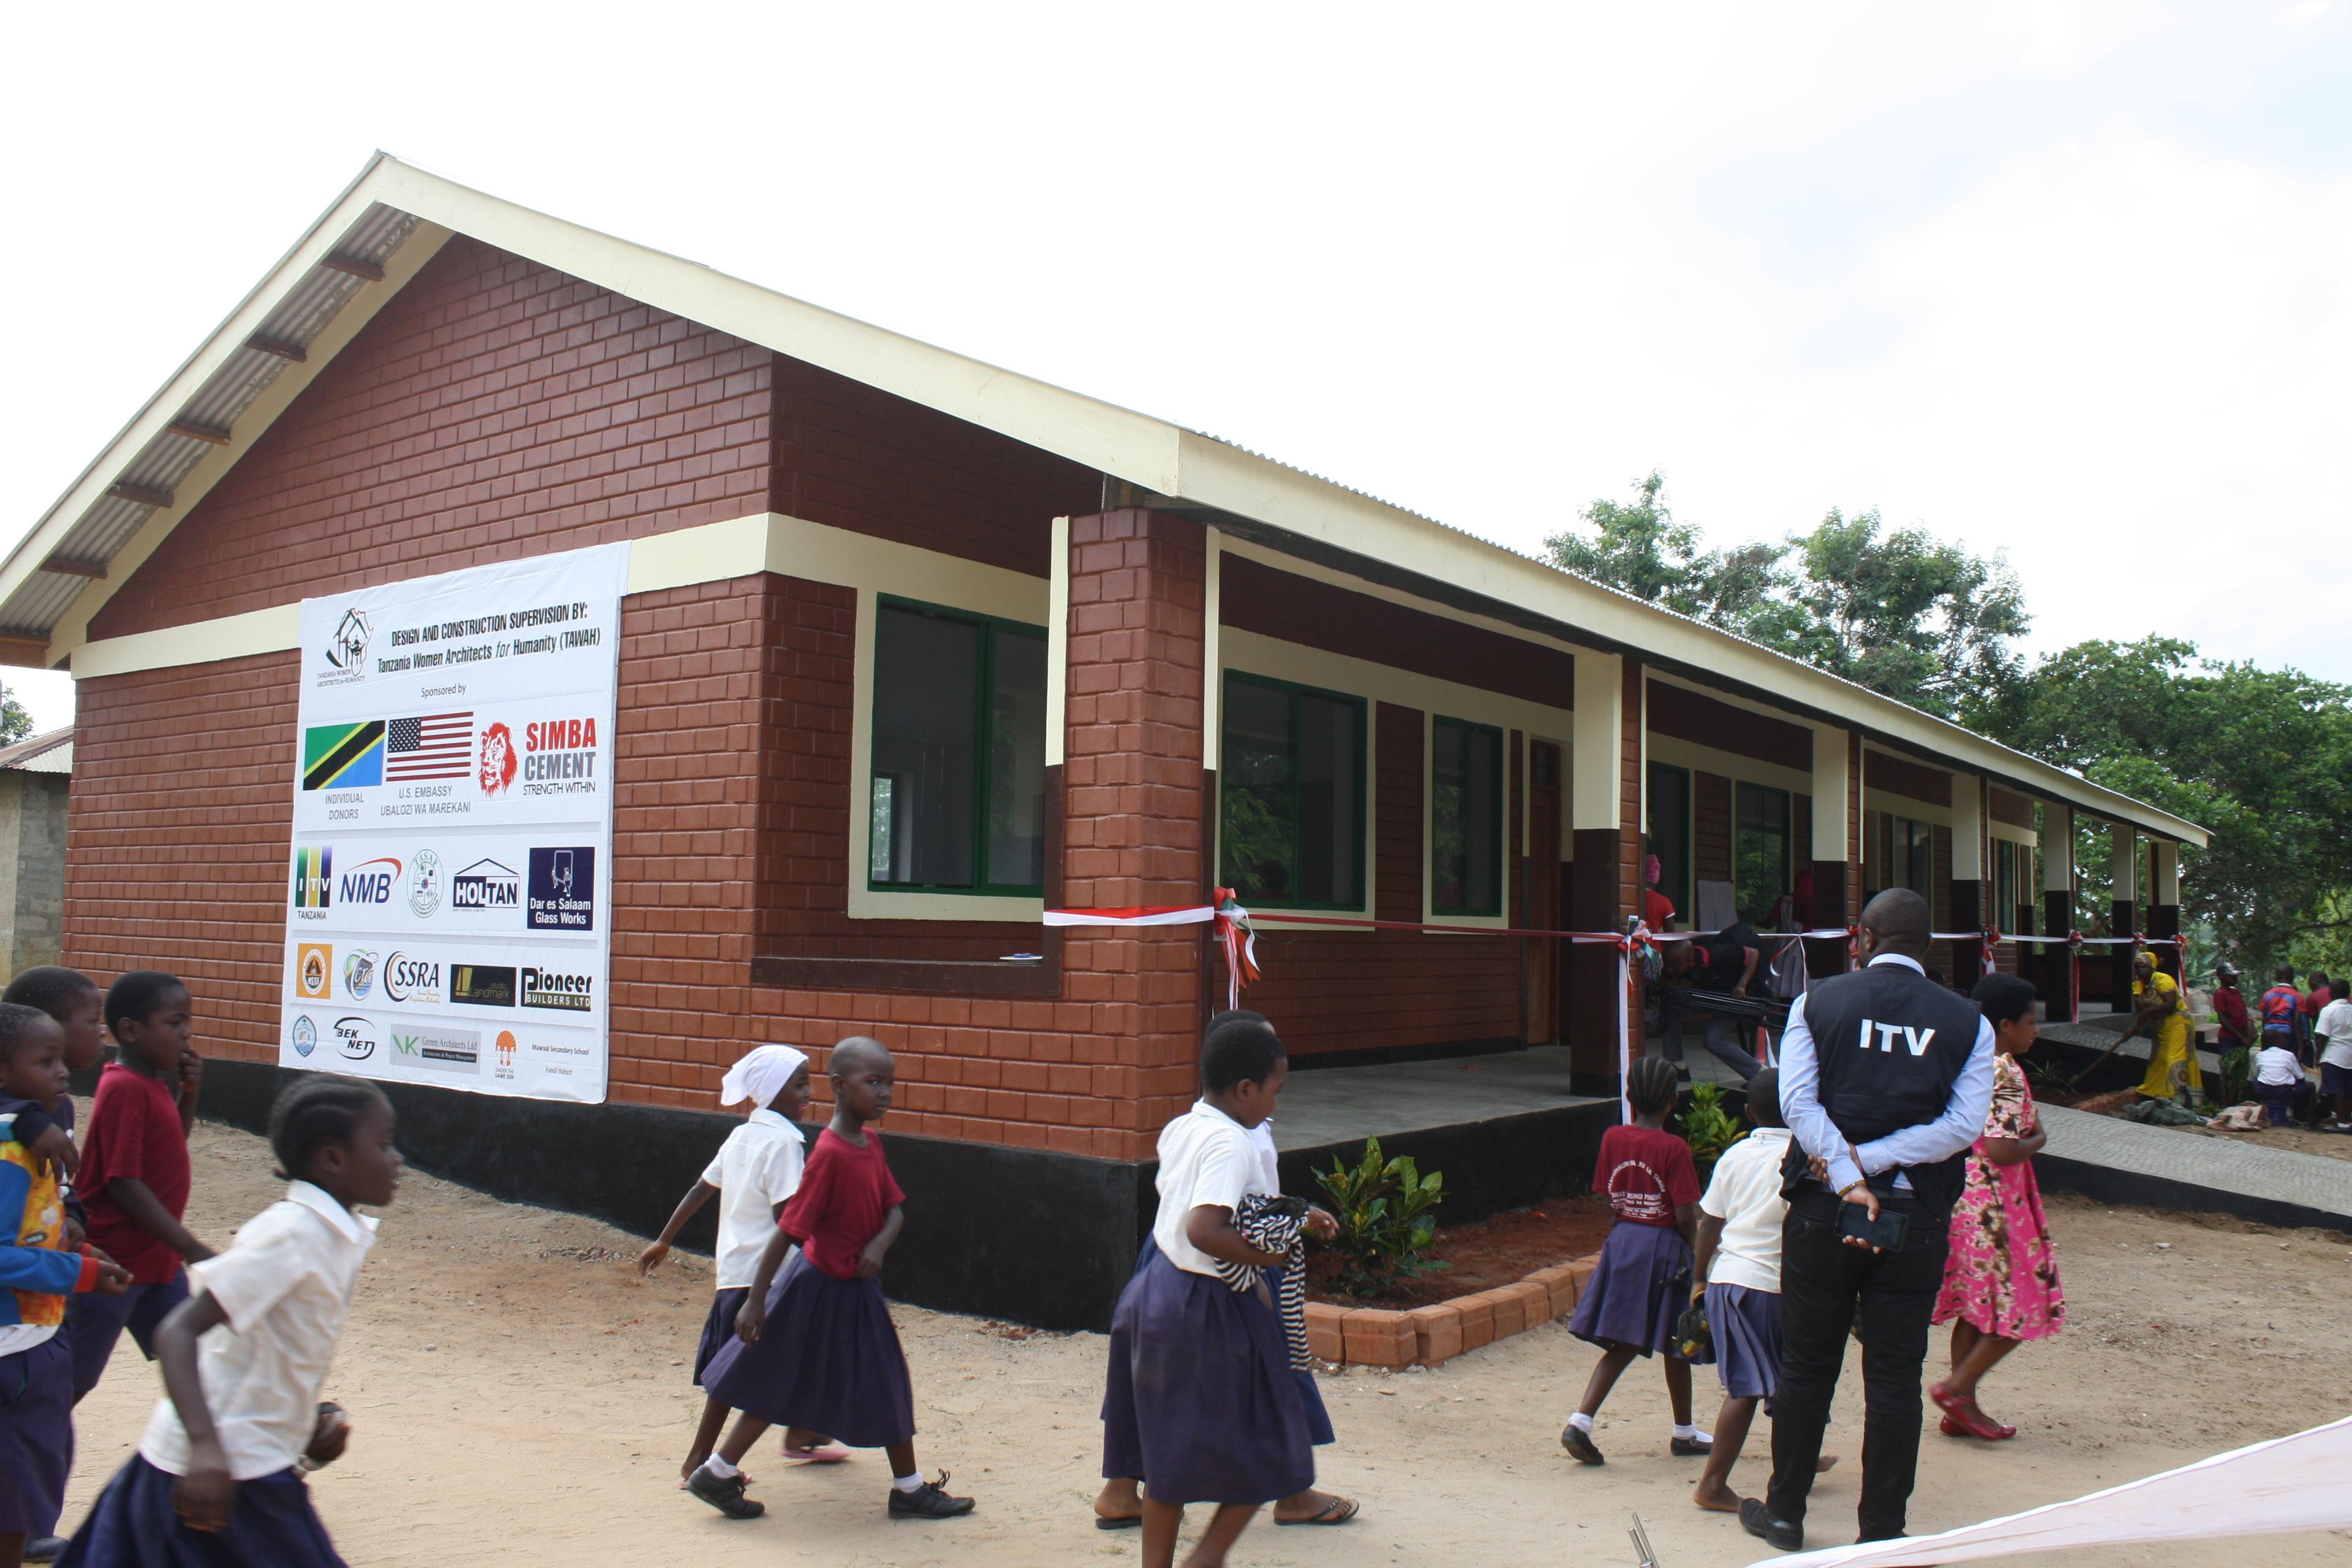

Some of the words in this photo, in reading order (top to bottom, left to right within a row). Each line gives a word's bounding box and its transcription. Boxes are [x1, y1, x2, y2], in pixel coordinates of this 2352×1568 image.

[392, 627, 420, 647] DESIGN
[422, 625, 439, 643] AND
[442, 614, 507, 639] CONSTRUCTION
[510, 604, 570, 629] SUPERVISION
[572, 601, 587, 620] BY:
[378, 654, 410, 674] Tanzania
[413, 652, 443, 669] Women
[445, 644, 492, 665] Architects
[496, 641, 511, 658] for
[513, 635, 557, 655] Humanity
[560, 627, 601, 650] (TAWAH)
[421, 684, 456, 698] Sponsored
[458, 684, 467, 696] by
[526, 718, 597, 752] SIMBA
[524, 752, 596, 781] CEMENT
[399, 788, 412, 799] U.S.
[415, 785, 453, 798] EMBASSY
[523, 783, 563, 796] STRENGTH
[565, 781, 596, 794] WITHIN
[325, 793, 364, 804] INDIVIDUAL
[329, 809, 359, 820] DONORS
[381, 804, 413, 816] UBALOZI
[415, 804, 426, 814] WA
[429, 802, 471, 814] MAREKANI
[415, 852, 439, 865] TASAF
[299, 878, 330, 892] ITV
[340, 873, 391, 903] NMB
[456, 883, 518, 905] HOLTAN
[530, 898, 544, 910] Dar
[547, 900, 556, 910] es
[559, 898, 590, 910] Salaam
[298, 911, 327, 919] TANZANIA
[535, 911, 558, 924] Glass
[560, 912, 586, 924] Works
[395, 960, 439, 988] SSRA
[521, 967, 592, 995] Pioneer
[470, 987, 510, 1000] Landmark
[527, 994, 570, 1005] BUILDERS
[575, 997, 590, 1006] LTD
[336, 1028, 360, 1039] BEK
[1860, 1019, 1936, 1056] ITV
[347, 1039, 371, 1050] NET
[422, 1036, 438, 1047] Green
[439, 1039, 466, 1049] Architects
[467, 1041, 477, 1050] Ltd
[551, 1046, 573, 1055] Secondary
